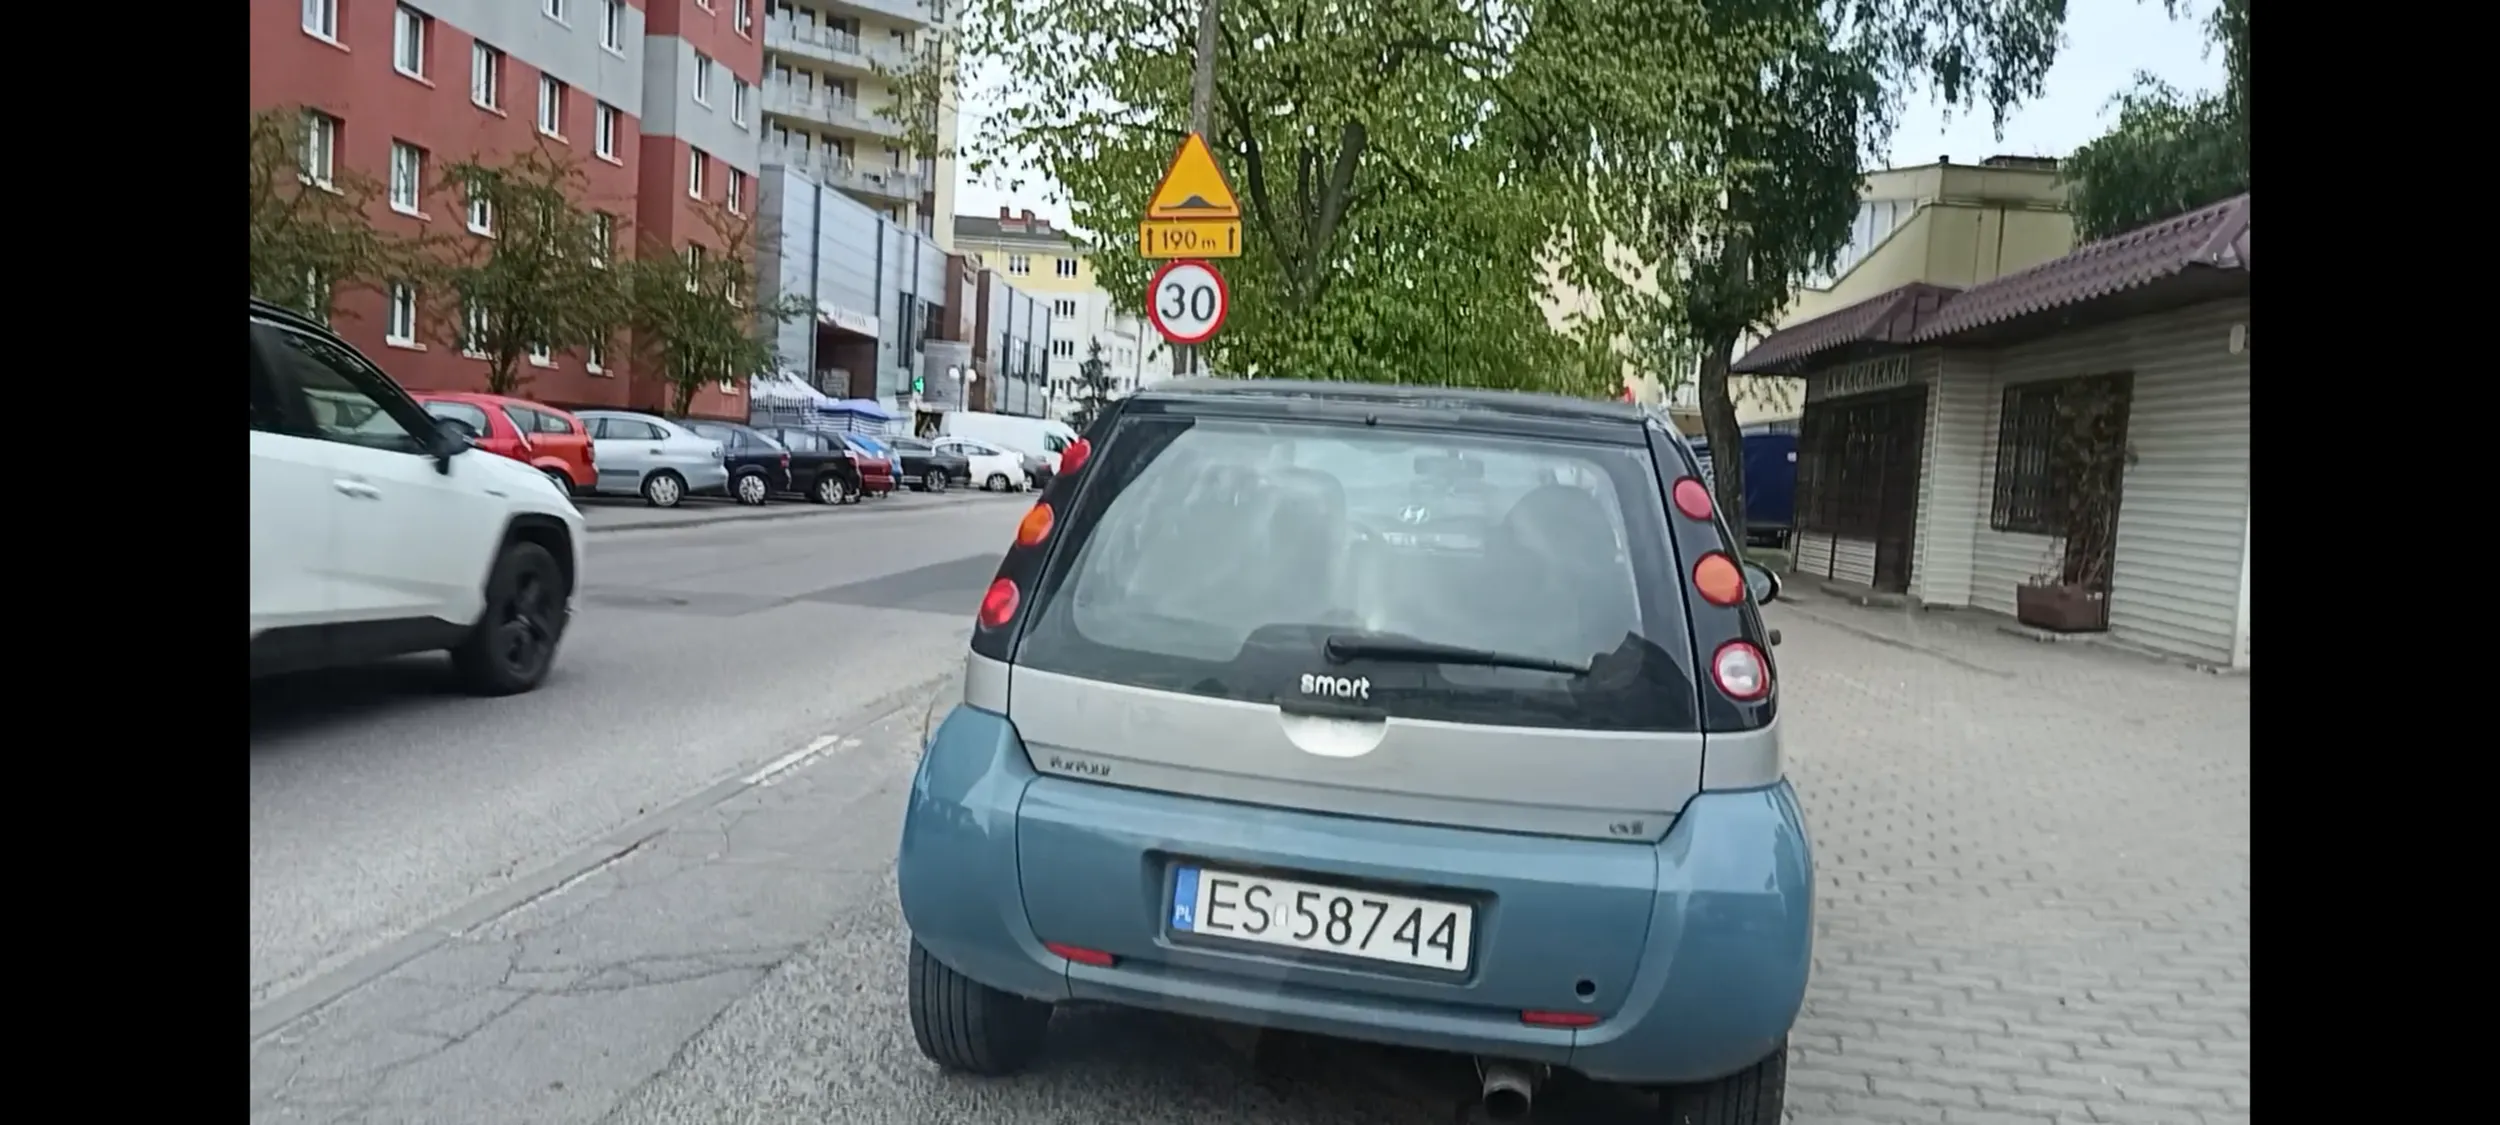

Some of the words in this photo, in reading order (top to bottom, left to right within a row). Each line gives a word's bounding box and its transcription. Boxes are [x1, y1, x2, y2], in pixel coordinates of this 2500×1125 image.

[1162, 228, 1198, 251] 190
[1201, 238, 1217, 250] m
[1161, 283, 1216, 322] 30
[1300, 673, 1371, 700] smart
[1174, 904, 1192, 923] PL
[1206, 878, 1273, 935] ES
[1292, 890, 1458, 963] 58744
